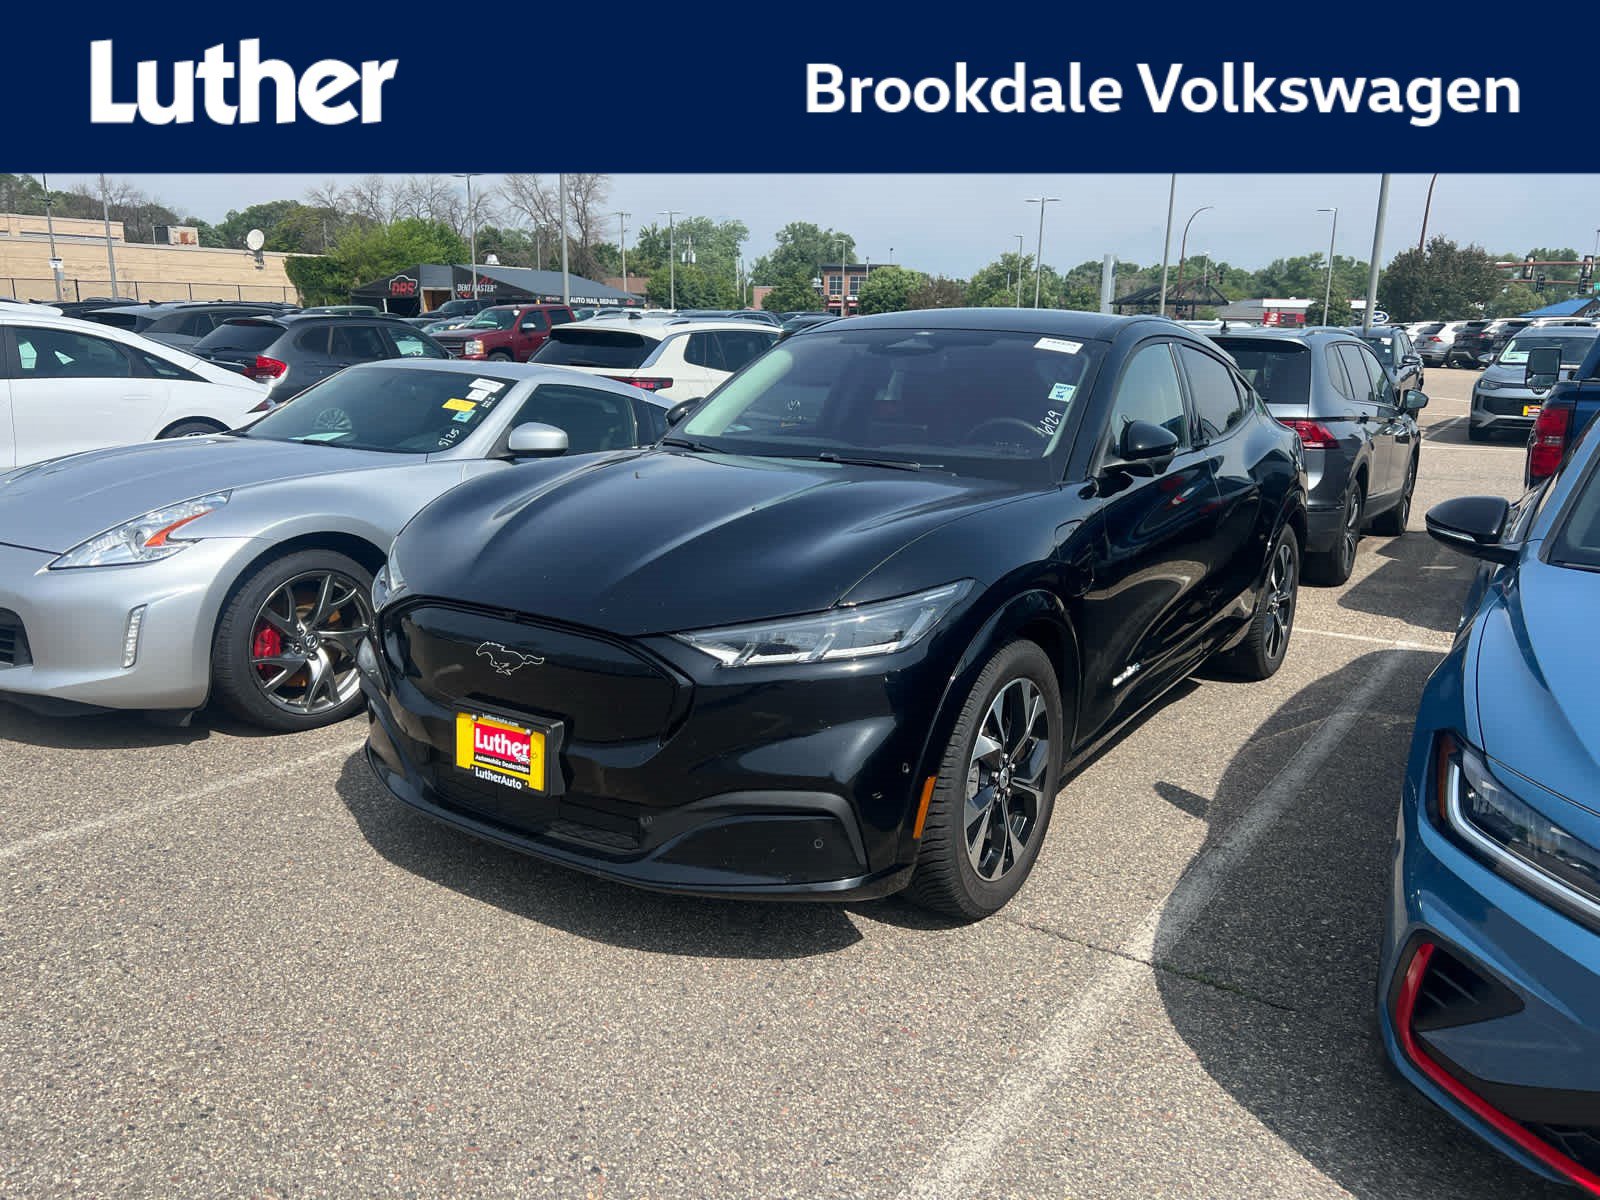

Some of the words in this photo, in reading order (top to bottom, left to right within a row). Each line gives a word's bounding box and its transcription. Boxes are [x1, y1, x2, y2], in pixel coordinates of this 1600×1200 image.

[457, 283, 471, 292] DENT
[570, 296, 586, 304] AUTO
[475, 727, 530, 758] Luther
[475, 766, 523, 790] LutherAuto
